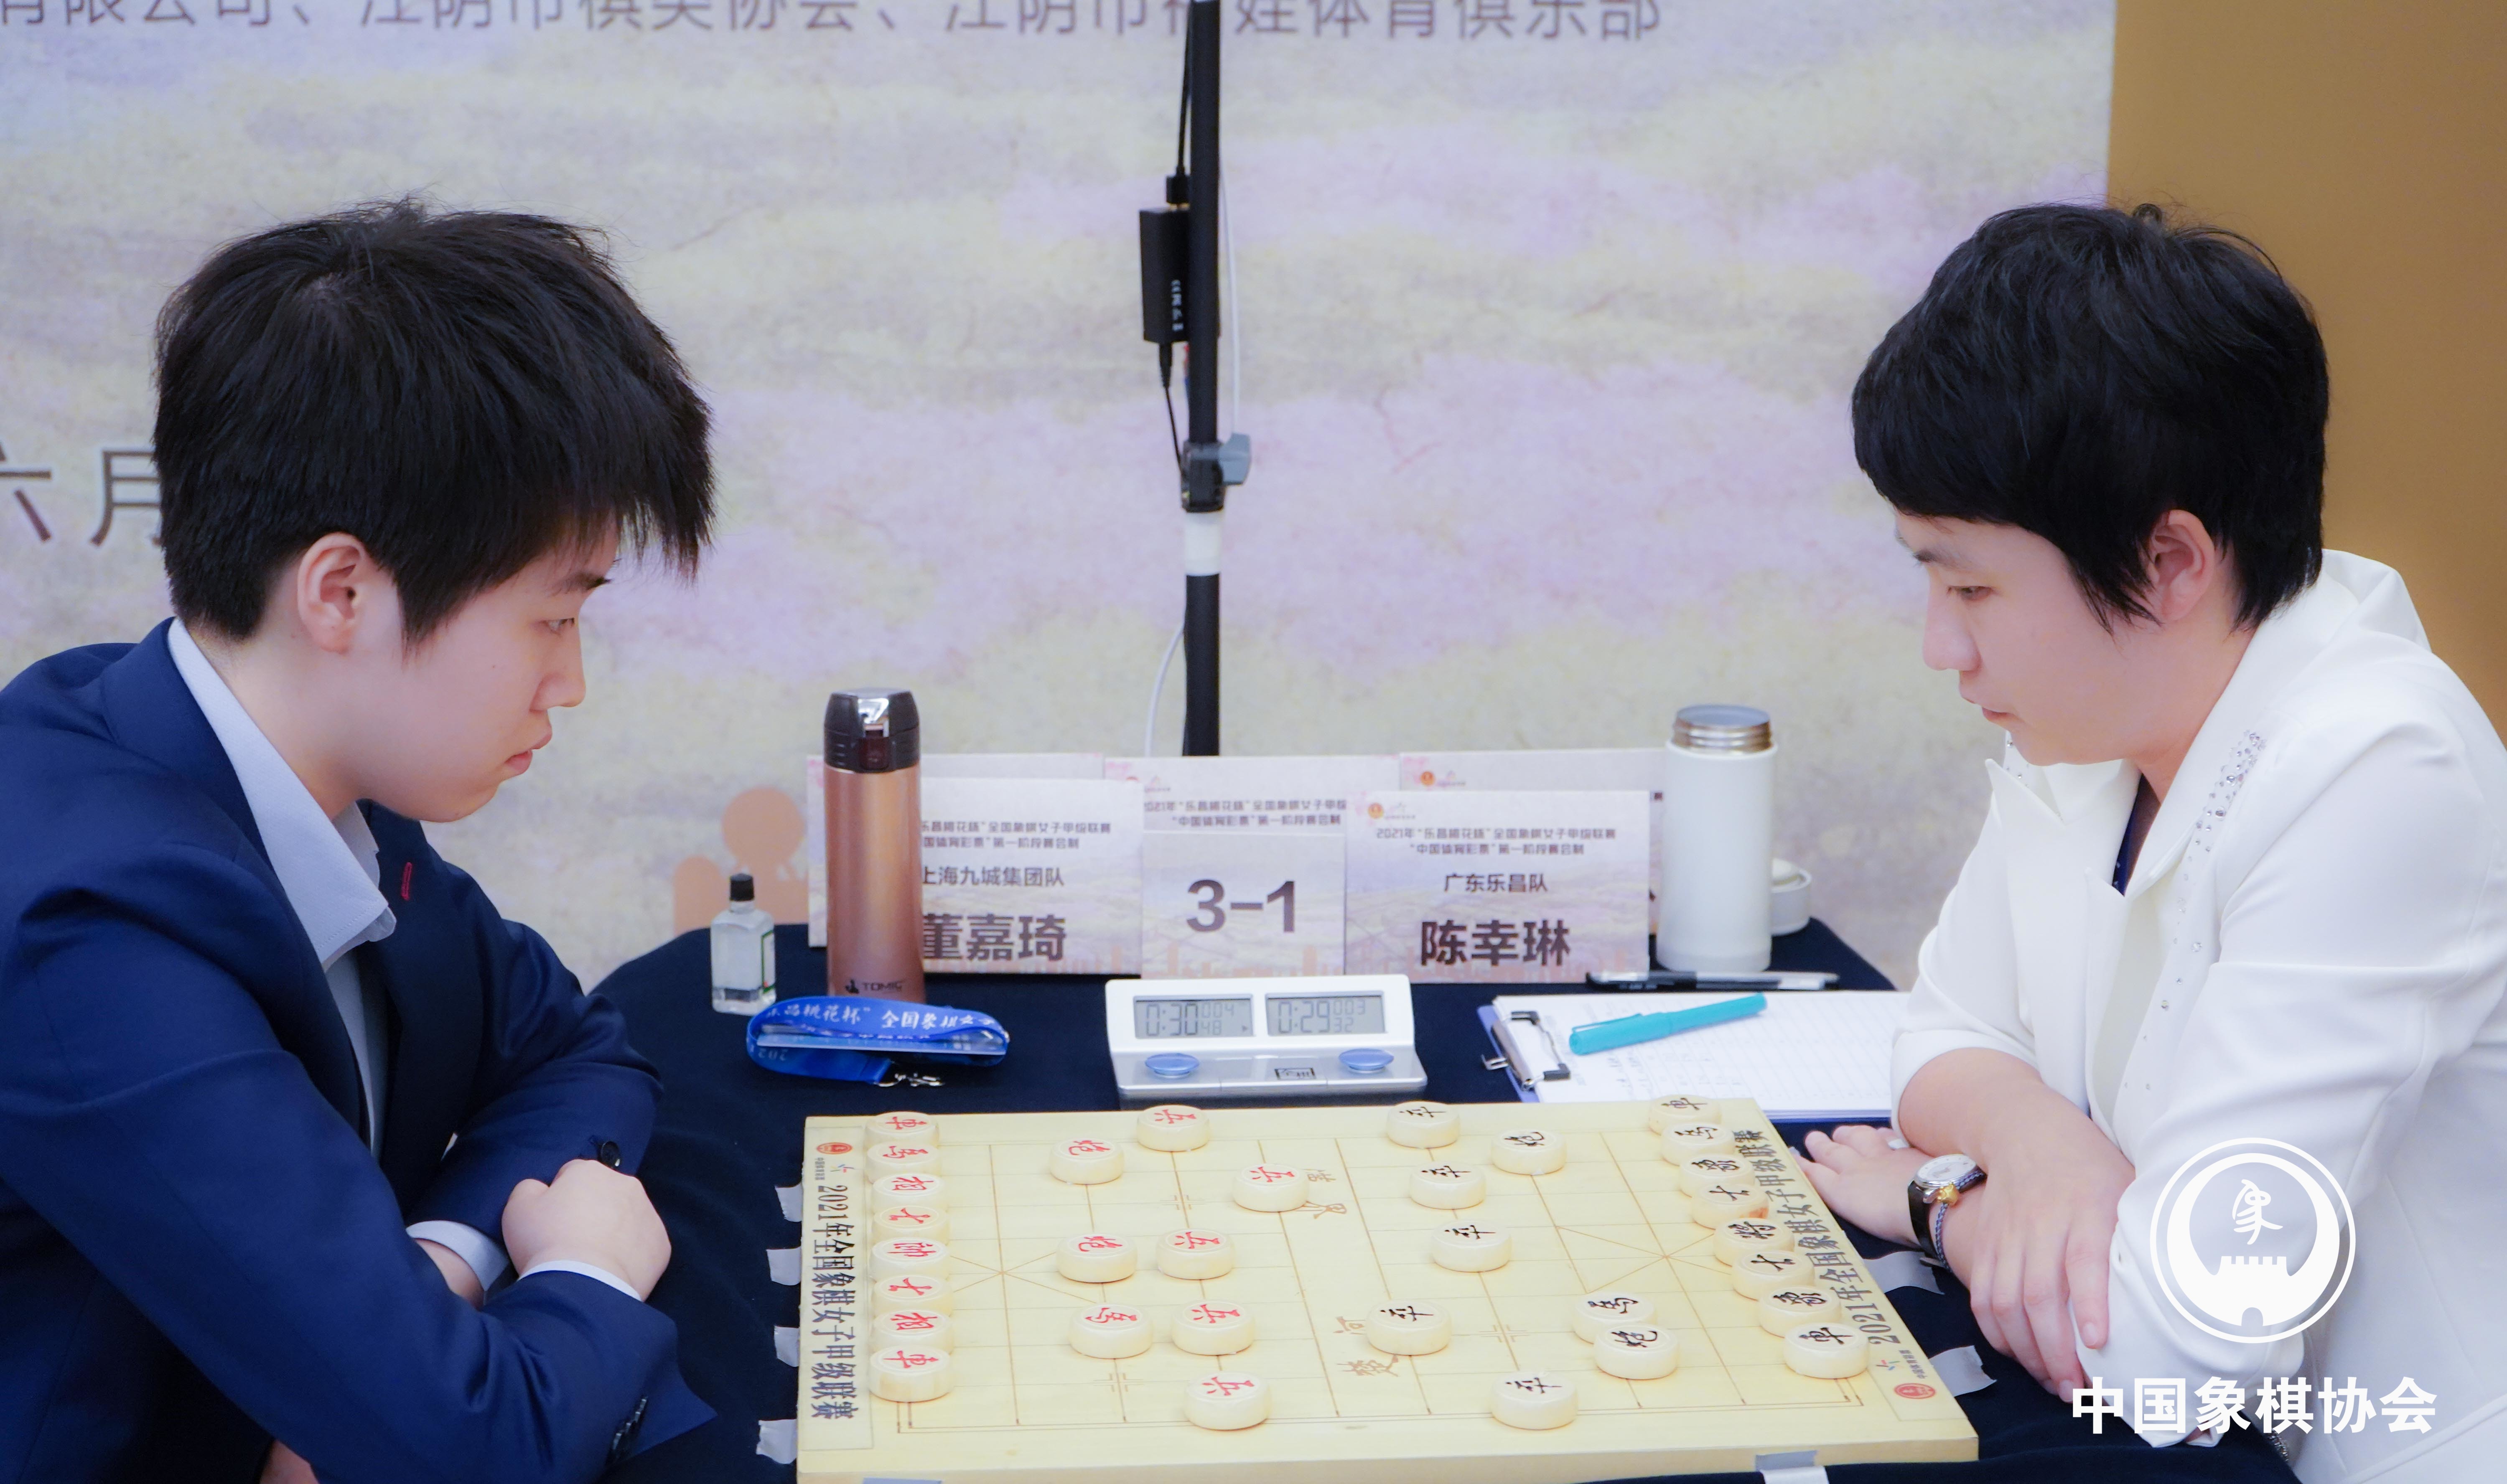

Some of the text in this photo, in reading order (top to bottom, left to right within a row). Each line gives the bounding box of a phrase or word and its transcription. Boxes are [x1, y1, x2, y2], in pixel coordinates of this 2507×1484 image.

[922, 866, 1065, 887] 上海九城集团队
[1444, 873, 1548, 893] 广东乐昌队
[923, 913, 1066, 962] 董嘉琦
[1420, 920, 1570, 967] 陈幸琳
[1146, 1003, 1198, 1036] 0:30
[1278, 1000, 1330, 1033] 0:29
[811, 1185, 859, 1419] 2021年全国象棋女子甲级联赛
